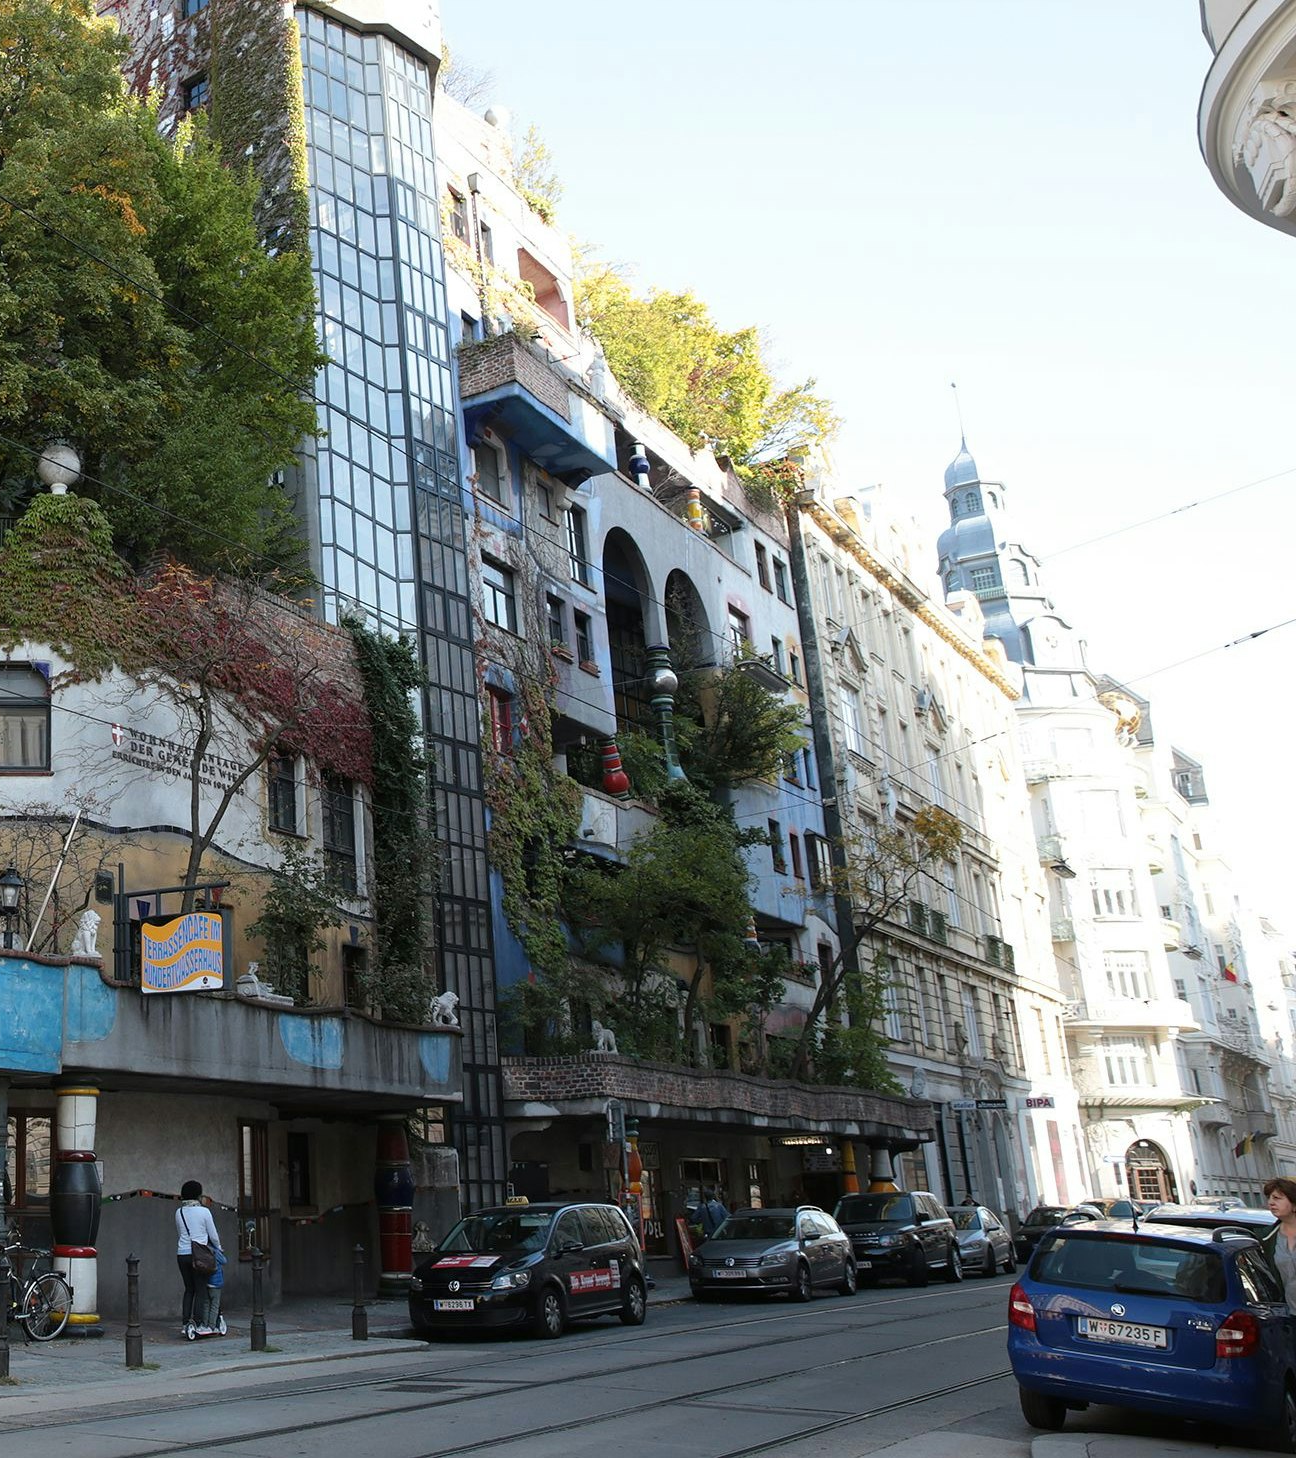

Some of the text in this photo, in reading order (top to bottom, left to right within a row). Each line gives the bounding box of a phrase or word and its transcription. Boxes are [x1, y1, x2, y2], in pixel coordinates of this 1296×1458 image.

[129, 728, 244, 773] WOHNHAUNLAGE
[130, 741, 244, 784] DER GEMEDE WIE
[182, 772, 212, 787] JAREN
[144, 948, 222, 988] HUNDERTWASSERHAUS
[1026, 1098, 1052, 1108] BIPA
